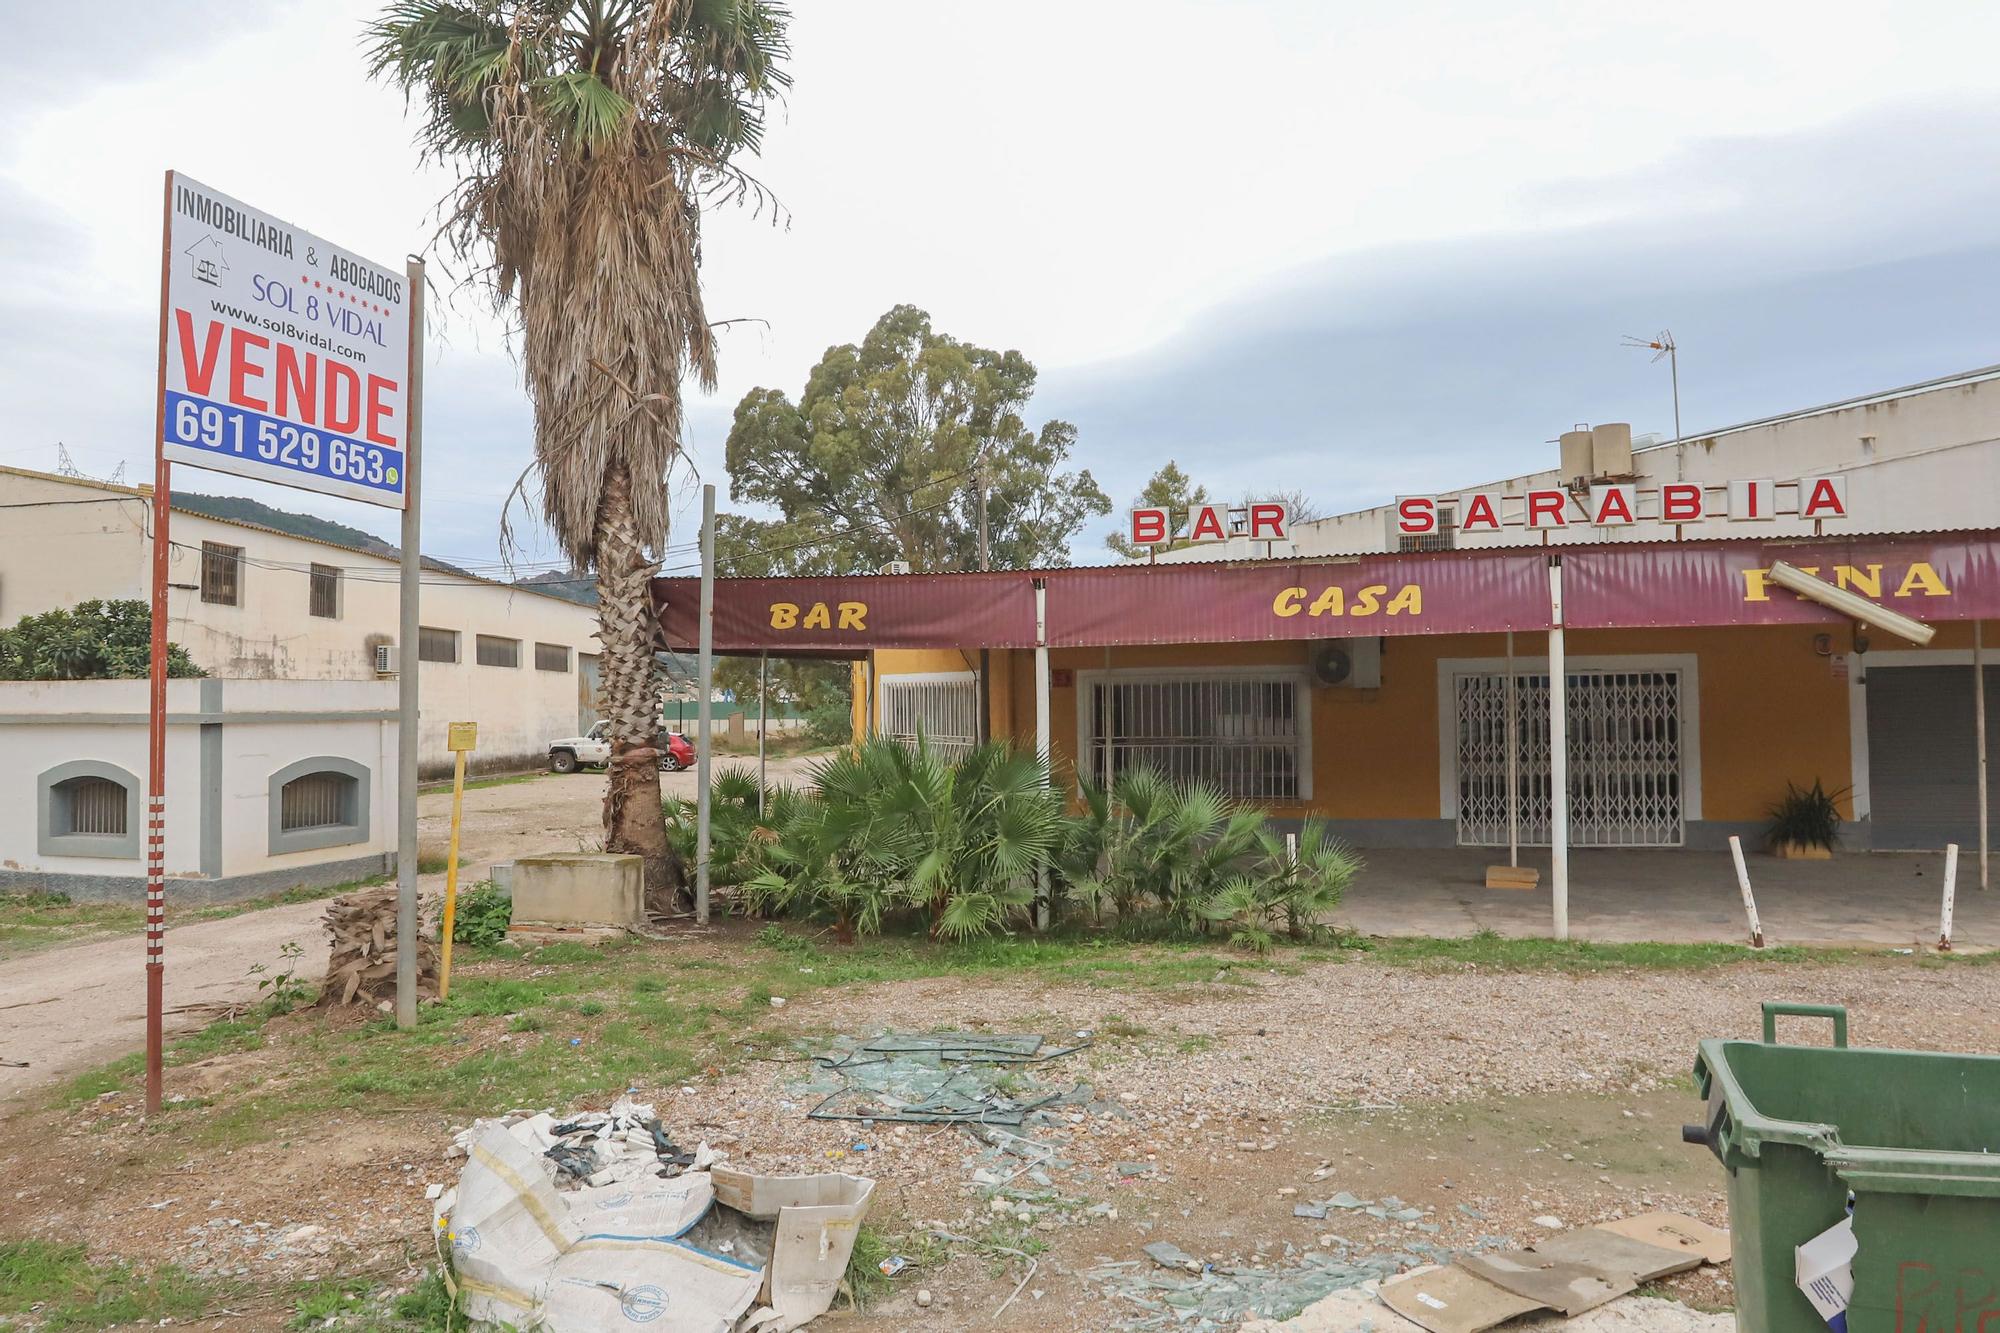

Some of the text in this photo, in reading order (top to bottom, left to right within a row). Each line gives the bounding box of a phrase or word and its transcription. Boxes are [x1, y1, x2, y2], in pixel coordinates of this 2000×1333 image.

[177, 185, 401, 305] INMOBILIARIA & ABOGADOS
[211, 299, 367, 363] www.sol8vidal.com
[252, 274, 299, 315] SOL
[326, 302, 387, 348] VIDAL
[176, 308, 398, 447] VENDE
[176, 399, 384, 485] 691 529 653
[1134, 479, 1844, 542] BAR SARABIA
[769, 602, 868, 631] BAR
[1272, 584, 1422, 618] CASA
